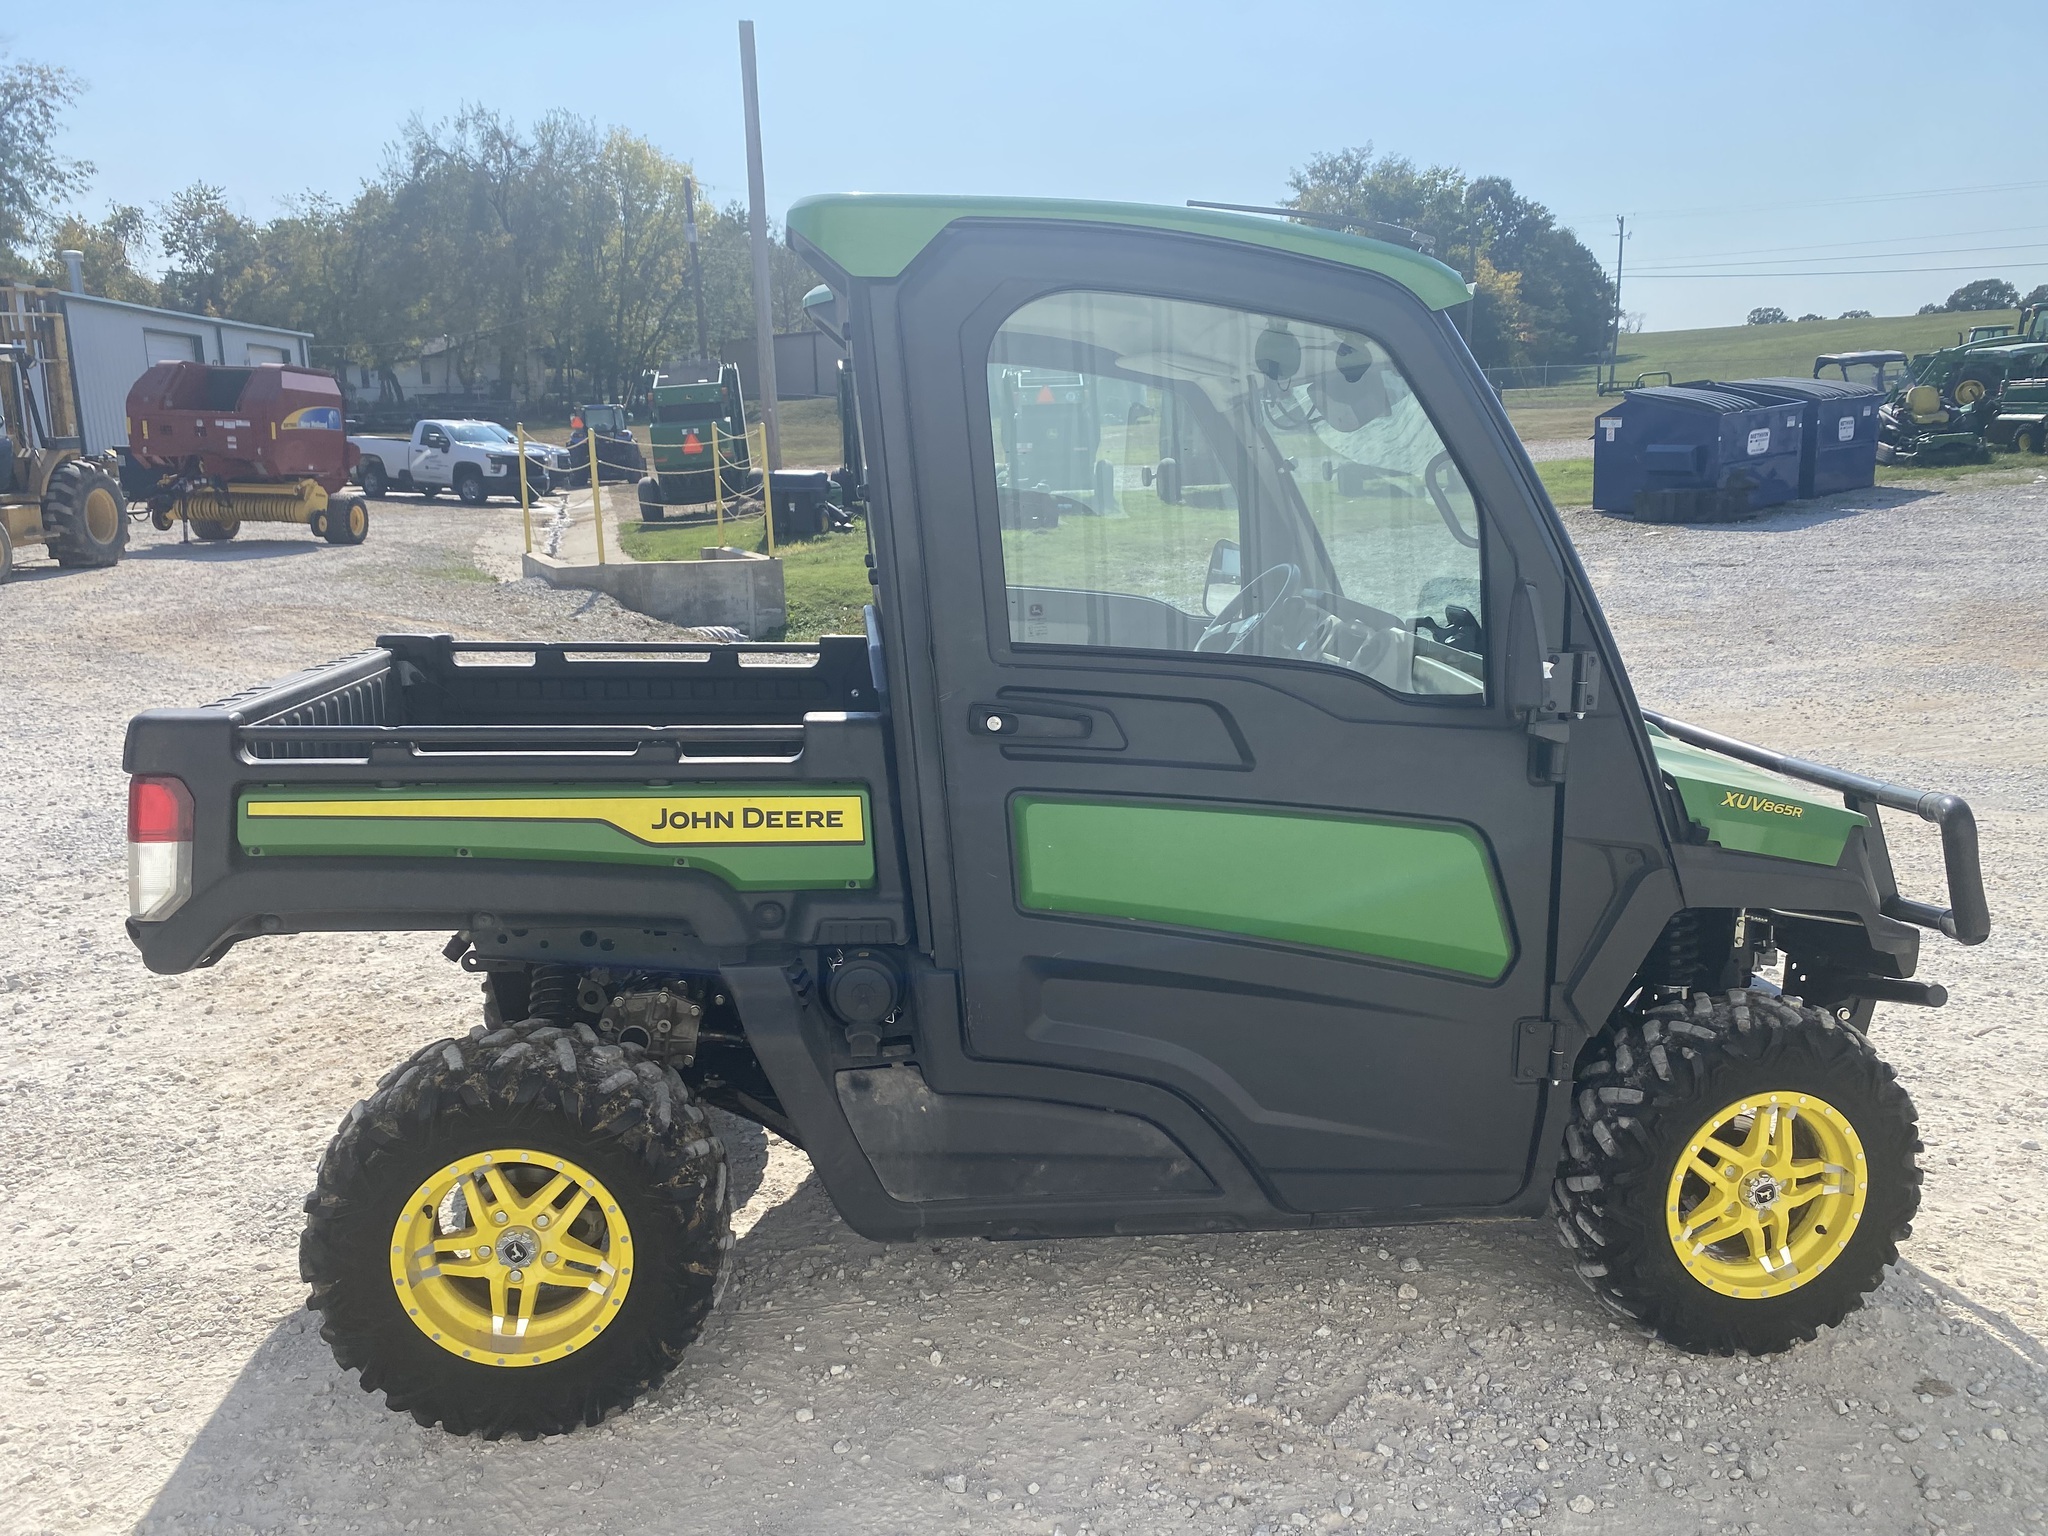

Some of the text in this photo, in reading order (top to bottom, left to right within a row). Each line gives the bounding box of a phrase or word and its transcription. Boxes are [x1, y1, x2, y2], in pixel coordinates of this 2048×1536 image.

[1720, 791, 1804, 818] XUV865R
[651, 807, 844, 829] JOHN DEERE
